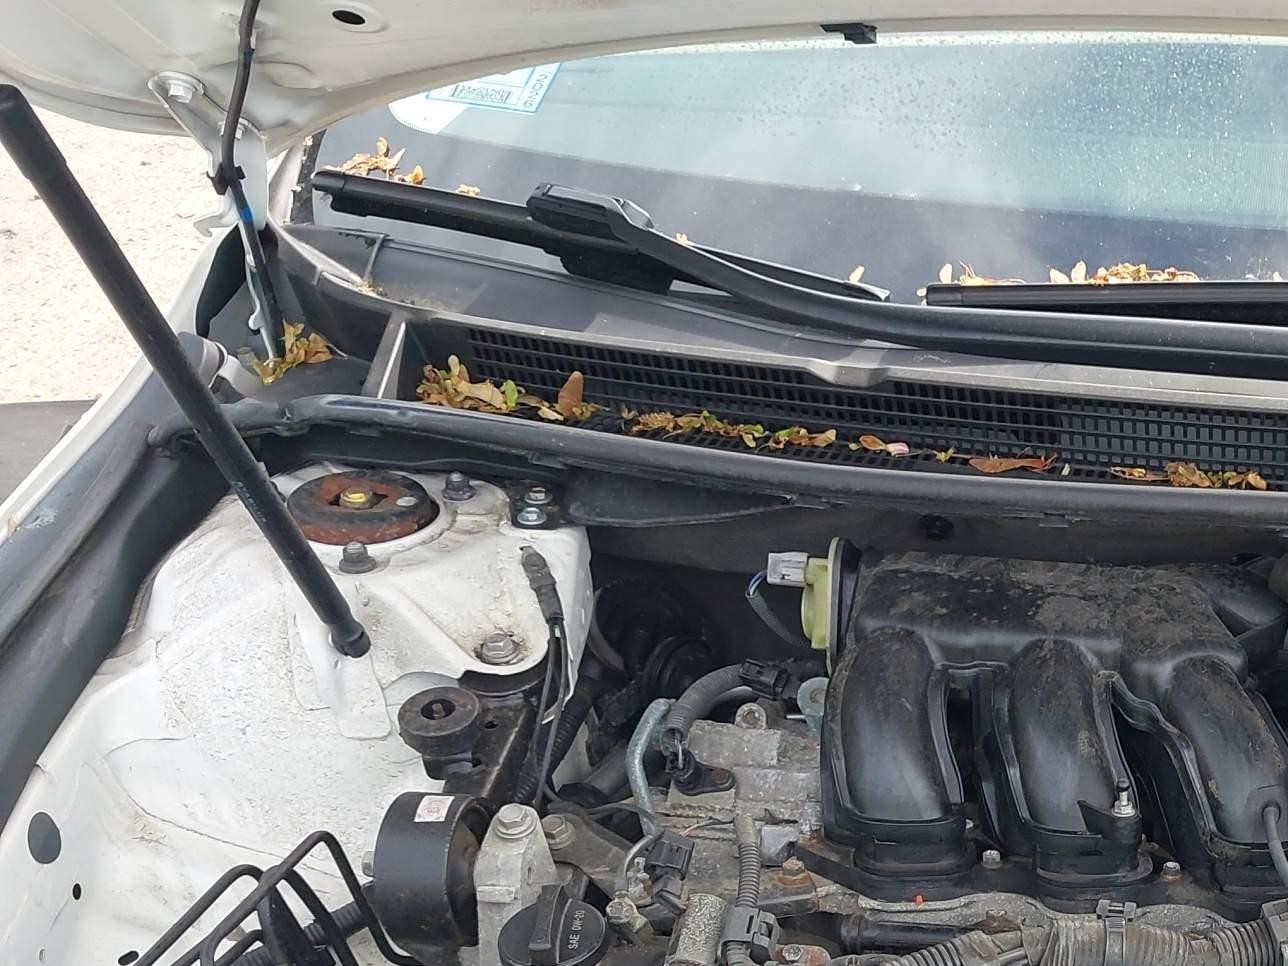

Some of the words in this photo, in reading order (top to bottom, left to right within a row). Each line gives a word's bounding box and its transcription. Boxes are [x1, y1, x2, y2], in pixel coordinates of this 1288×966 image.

[522, 74, 548, 108] 2026
[571, 910, 586, 931] 0W-20
[567, 934, 580, 950] SAE
